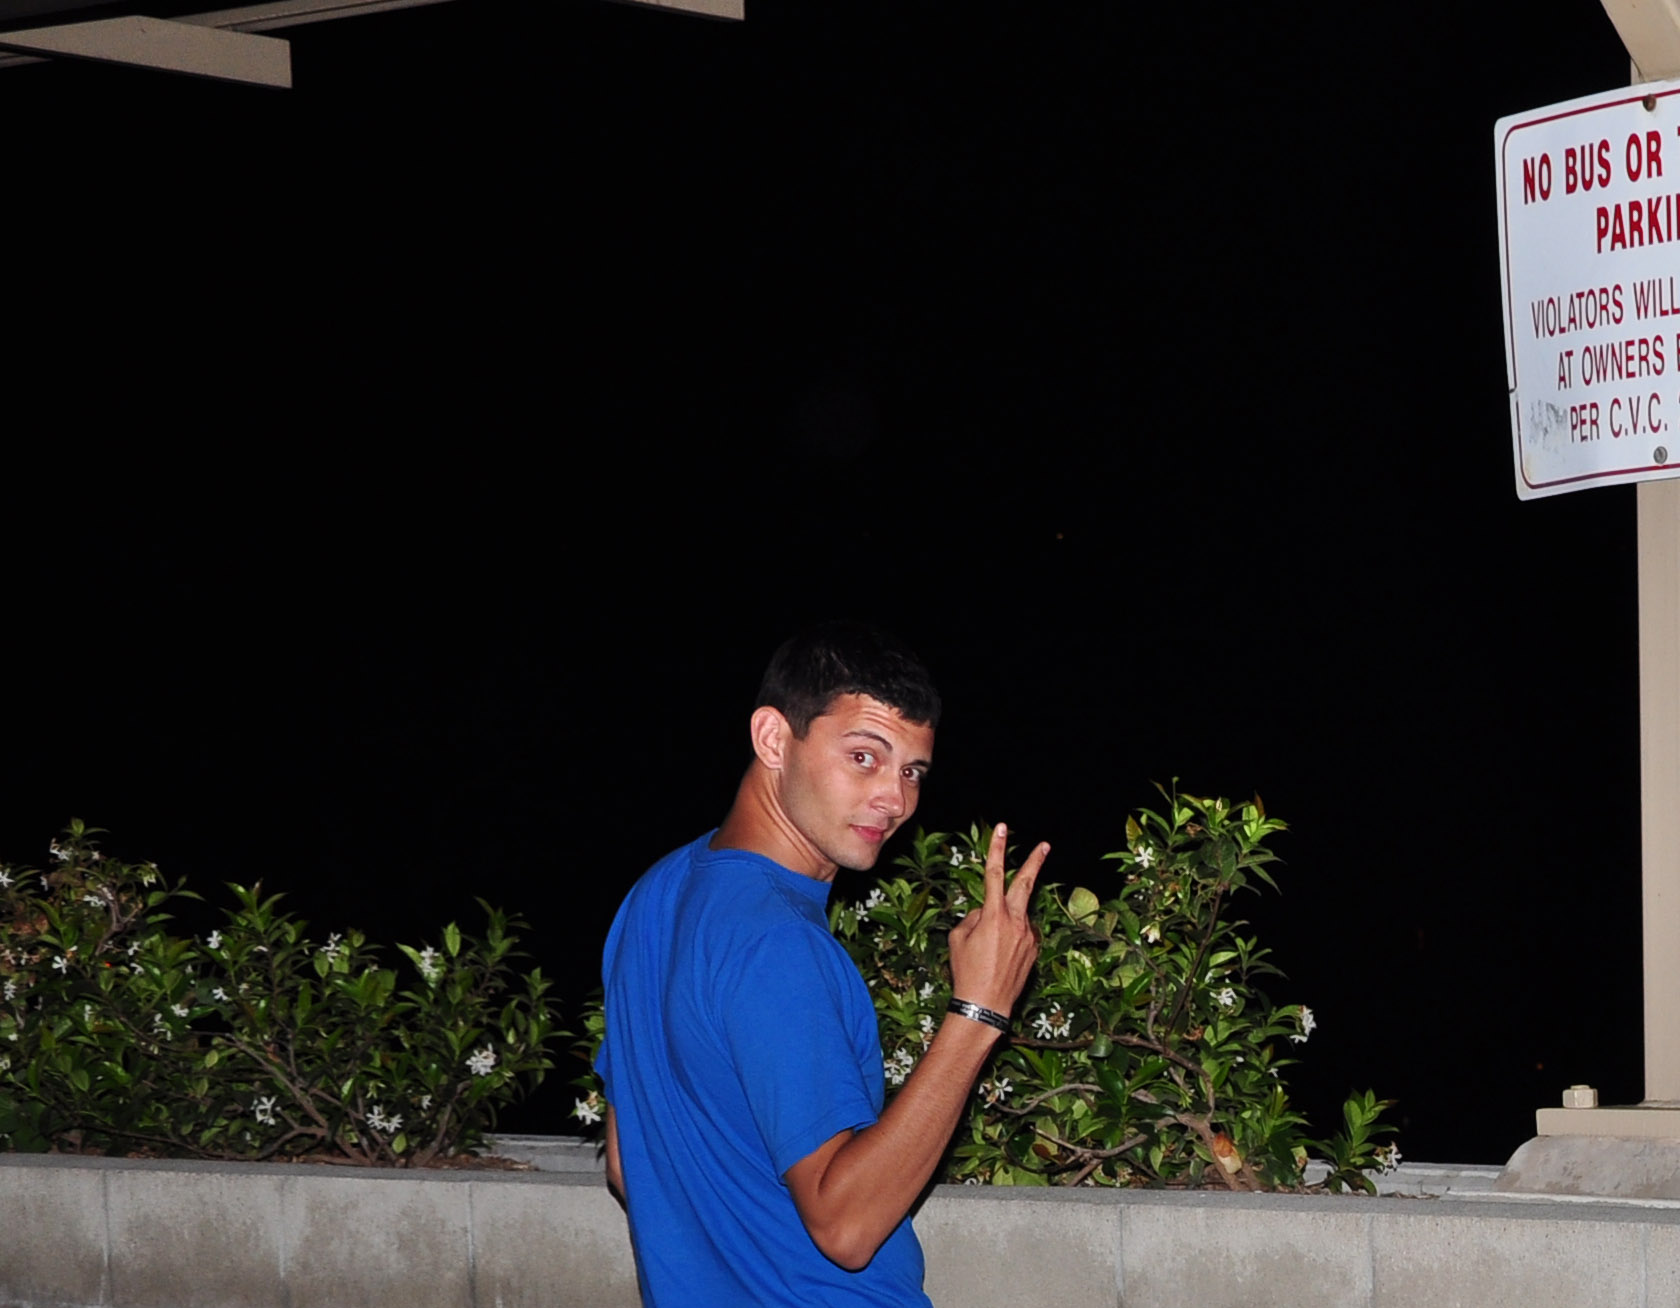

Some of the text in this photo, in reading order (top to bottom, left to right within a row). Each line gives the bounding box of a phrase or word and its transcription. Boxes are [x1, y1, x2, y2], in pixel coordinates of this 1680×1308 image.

[1523, 156, 1552, 206] NO
[1565, 139, 1612, 196] BUS
[1626, 130, 1663, 183] OR
[1531, 284, 1625, 340] VIOLATORS
[1558, 349, 1575, 392] AT
[1582, 335, 1665, 387] OWNERS
[1570, 402, 1600, 443] PER
[1610, 393, 1669, 439] C.V.C.
